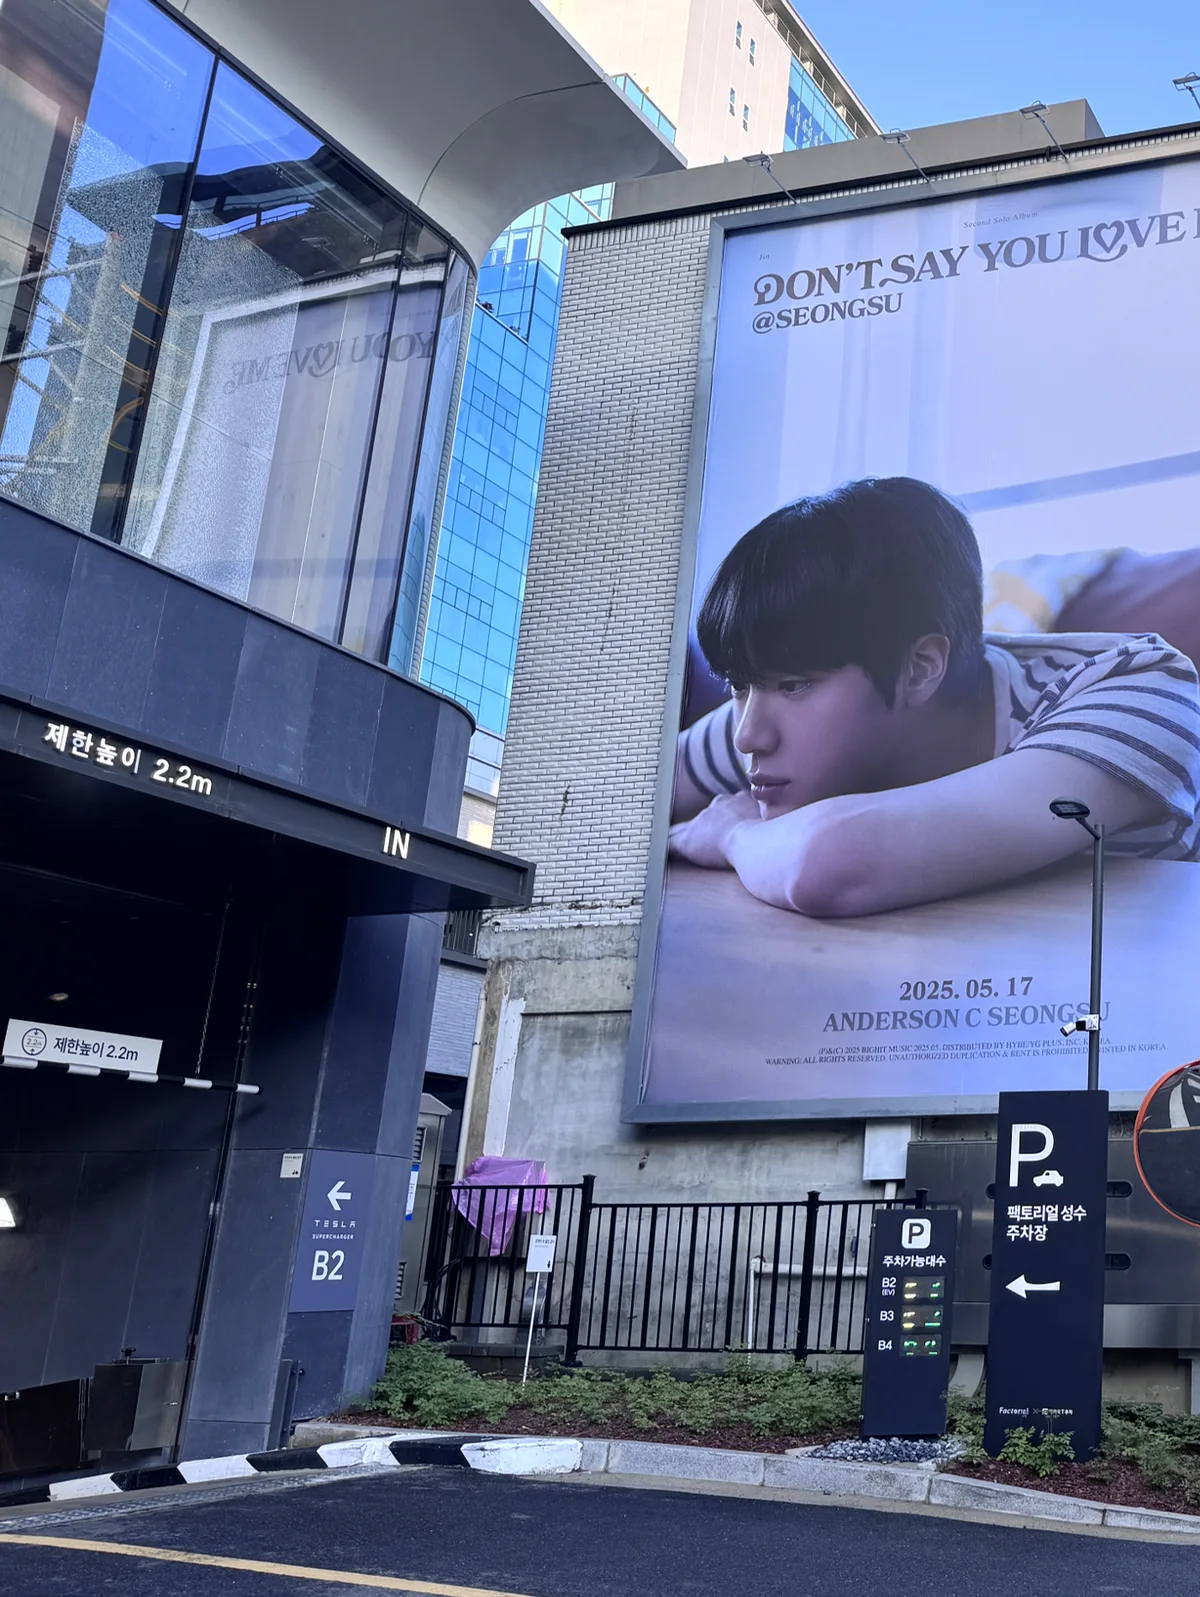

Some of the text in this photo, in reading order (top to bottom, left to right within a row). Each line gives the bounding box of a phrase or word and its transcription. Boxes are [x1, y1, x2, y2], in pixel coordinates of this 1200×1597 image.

[963, 211, 1038, 229] Second Solo Album
[879, 245, 969, 287] SAY
[977, 230, 1068, 272] YOU
[752, 292, 904, 334] @SEONGSU
[44, 722, 212, 795] 제한높이 2.2m
[383, 826, 411, 860] IN
[899, 976, 1033, 1001] 2025. 05. 17
[822, 1008, 961, 1033] ANDERSON
[965, 1007, 981, 1028] C
[53, 1036, 138, 1061] 제한높이 2.2m
[845, 1046, 860, 1054] 2025
[862, 1045, 887, 1054] BIGHIT
[889, 1044, 913, 1053] MUSIC
[942, 1042, 992, 1051] DISTRIBUTED
[993, 1042, 1005, 1050] BY
[1083, 1037, 1113, 1045] KEA.
[765, 1057, 802, 1065] WARNING:
[803, 1056, 817, 1064] ALL
[818, 1055, 846, 1063] RIGHTS
[889, 1052, 949, 1061] UNAUTHORIZED
[950, 1051, 1000, 1060] DUPLICATION
[1002, 1050, 1008, 1058] &
[1010, 1049, 1032, 1057] RENT
[1008, 1123, 1056, 1188] P
[1007, 1204, 1087, 1222] 팩토리얼 성수
[314, 1220, 356, 1228] TESLA
[907, 1222, 925, 1244] P
[1006, 1223, 1048, 1242] 주차장
[311, 1250, 345, 1281] B2
[882, 1255, 946, 1268] 주차가능대수
[882, 1277, 896, 1288] B2
[882, 1288, 895, 1296] (EV)
[880, 1310, 894, 1321] B3
[878, 1340, 892, 1350] B4
